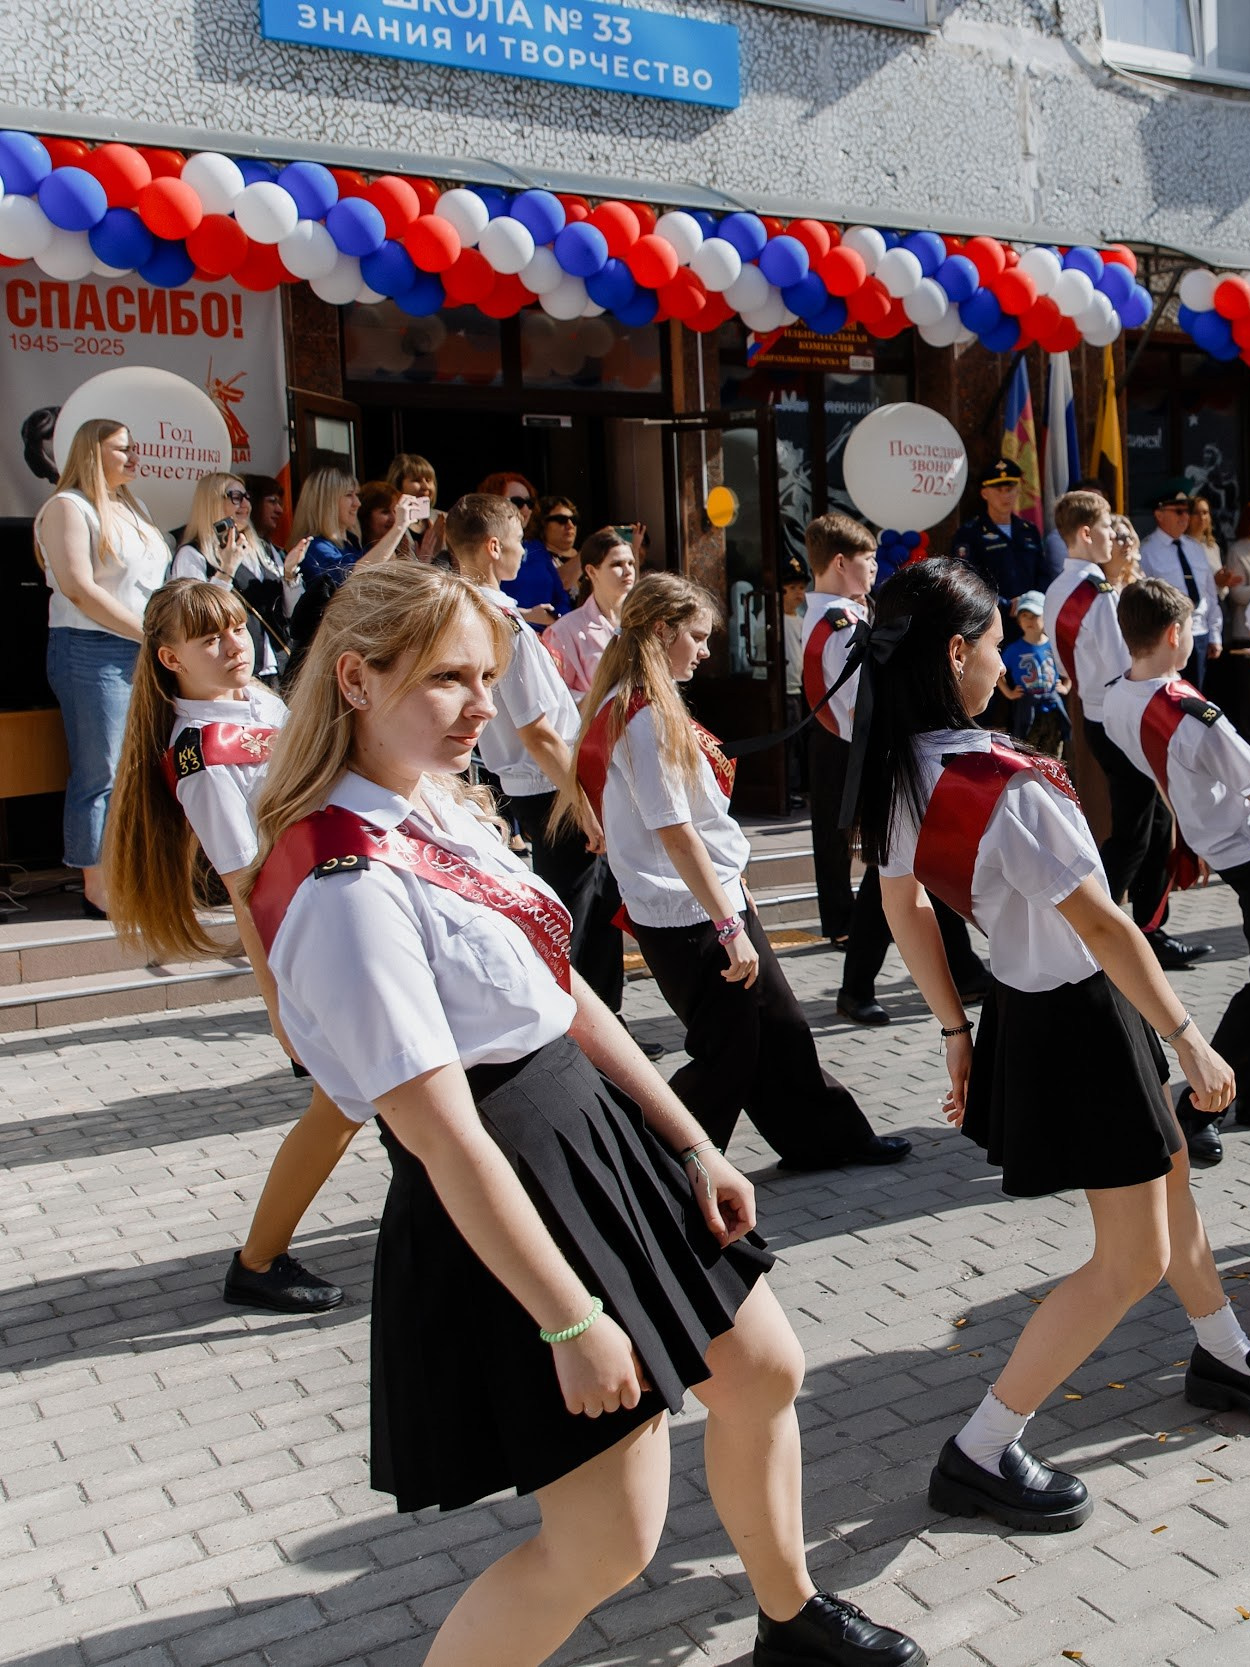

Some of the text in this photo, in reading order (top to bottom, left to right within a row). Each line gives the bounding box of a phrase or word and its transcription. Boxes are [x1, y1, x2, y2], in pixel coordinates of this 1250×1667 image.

[545, 9, 584, 35] №
[592, 13, 634, 46] 33
[297, 4, 714, 92] ЗНАНИЯ И ТВОРЧЕСТВО
[5, 278, 244, 340] СПАСИБО!
[159, 421, 194, 444] Год
[132, 441, 222, 464] ащитника
[178, 745, 197, 763] КК
[180, 757, 201, 775] 33
